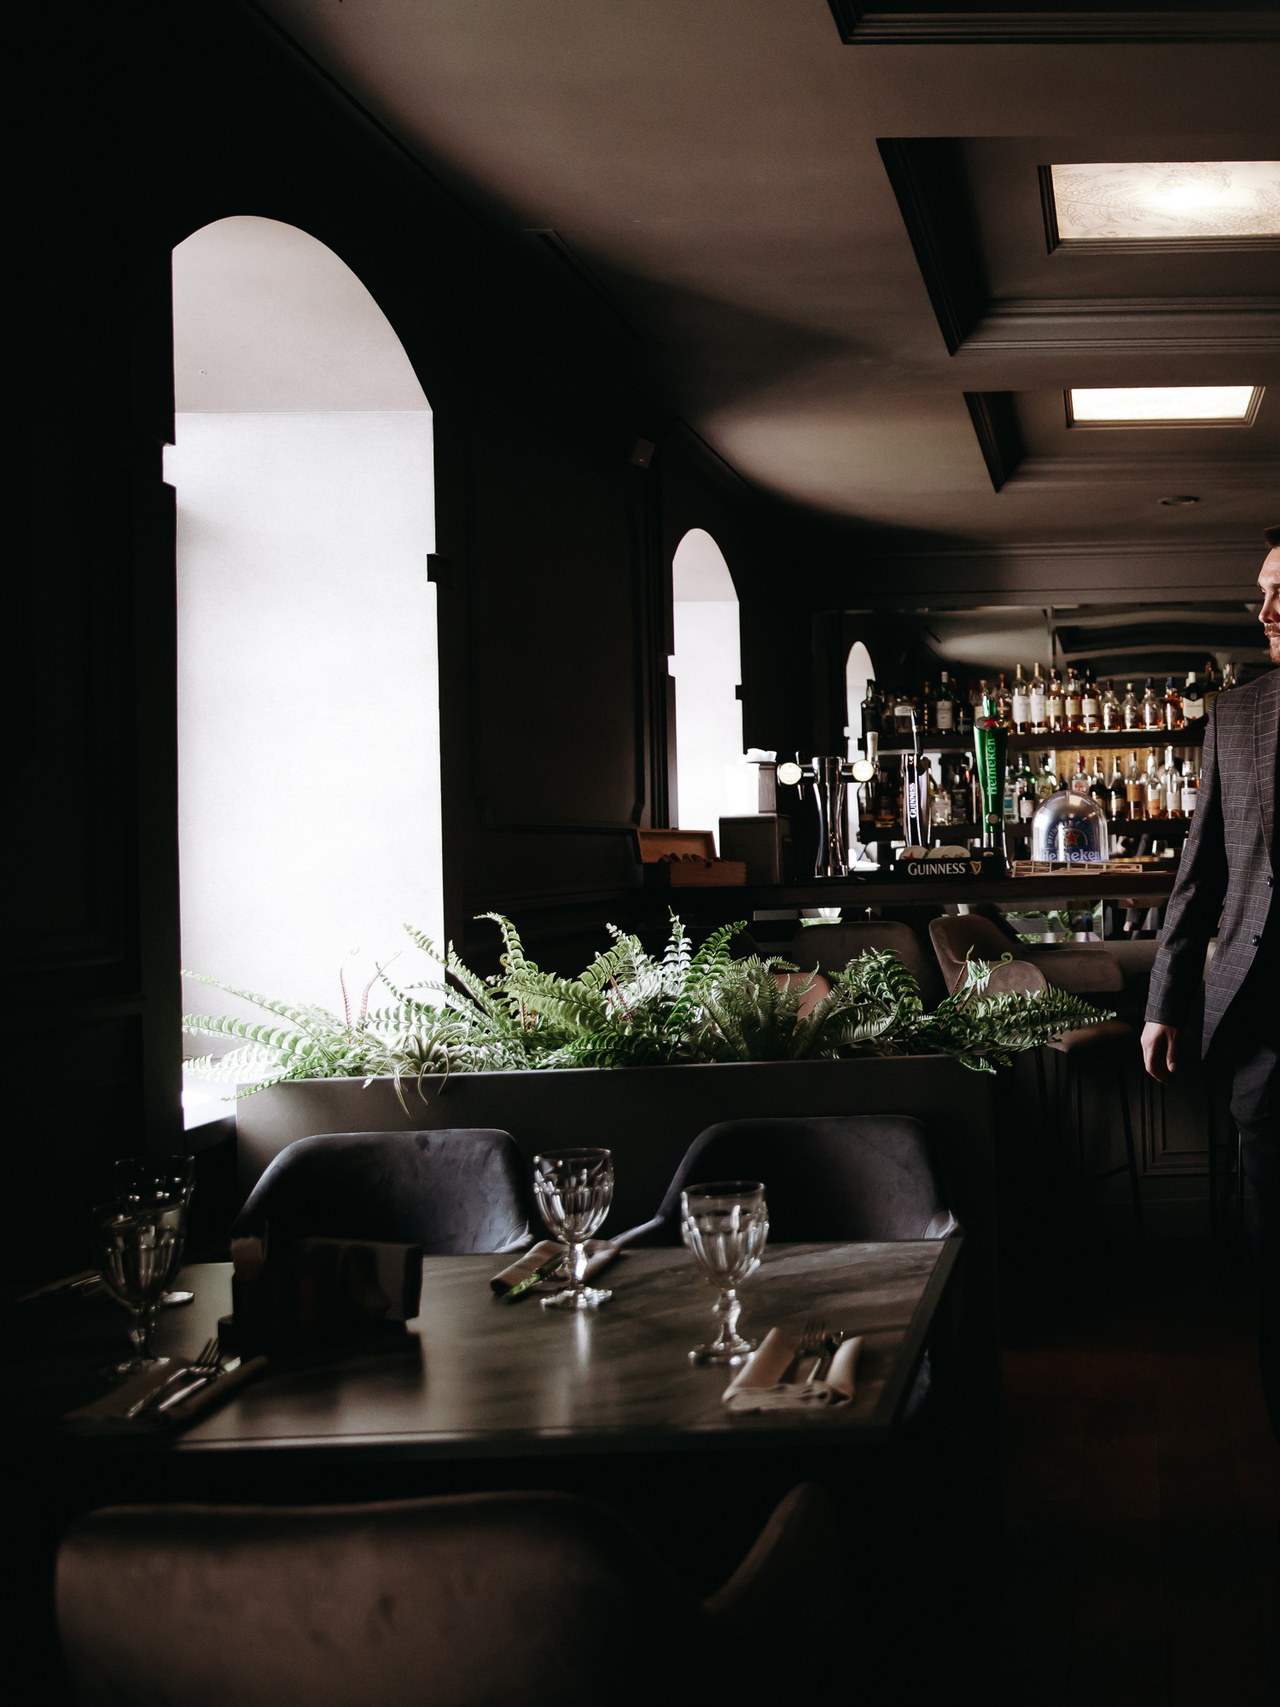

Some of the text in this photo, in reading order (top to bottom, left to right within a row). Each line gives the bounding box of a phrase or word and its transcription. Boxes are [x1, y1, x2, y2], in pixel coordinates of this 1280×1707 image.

[986, 738, 998, 795] Heineken
[909, 782, 917, 819] GUINNESS
[907, 862, 966, 876] GUINNESS
